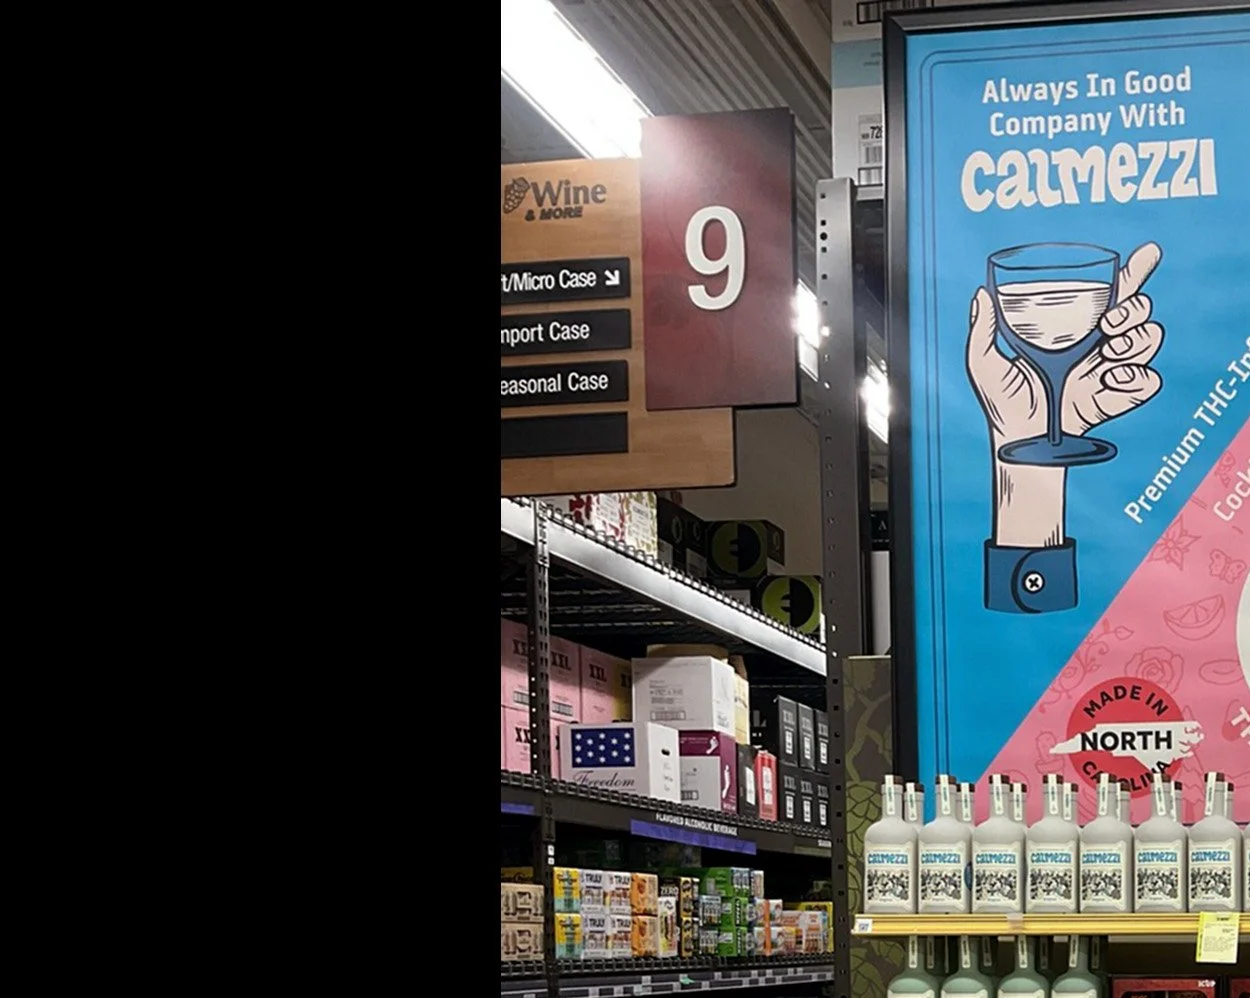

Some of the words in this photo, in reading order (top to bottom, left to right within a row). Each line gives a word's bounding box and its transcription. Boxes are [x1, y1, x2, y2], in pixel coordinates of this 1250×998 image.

[982, 76, 1079, 106] Always
[1086, 73, 1116, 97] In
[1124, 65, 1192, 94] Good
[989, 109, 1112, 140] Company
[1119, 100, 1186, 128] With
[530, 179, 607, 208] Wine
[524, 208, 536, 222] &
[539, 206, 584, 220] MORE
[685, 205, 746, 312] 9
[558, 269, 597, 290] Case
[549, 321, 590, 342] Case
[567, 371, 609, 392] Case
[1124, 426, 1205, 524] Premium
[1083, 685, 1143, 719] MADE
[1145, 691, 1168, 717] IN
[1080, 729, 1173, 752] NORTH
[573, 770, 635, 788] Freedom
[684, 817, 713, 832] ALCOHOLIC
[713, 823, 738, 836] BEVERAGE
